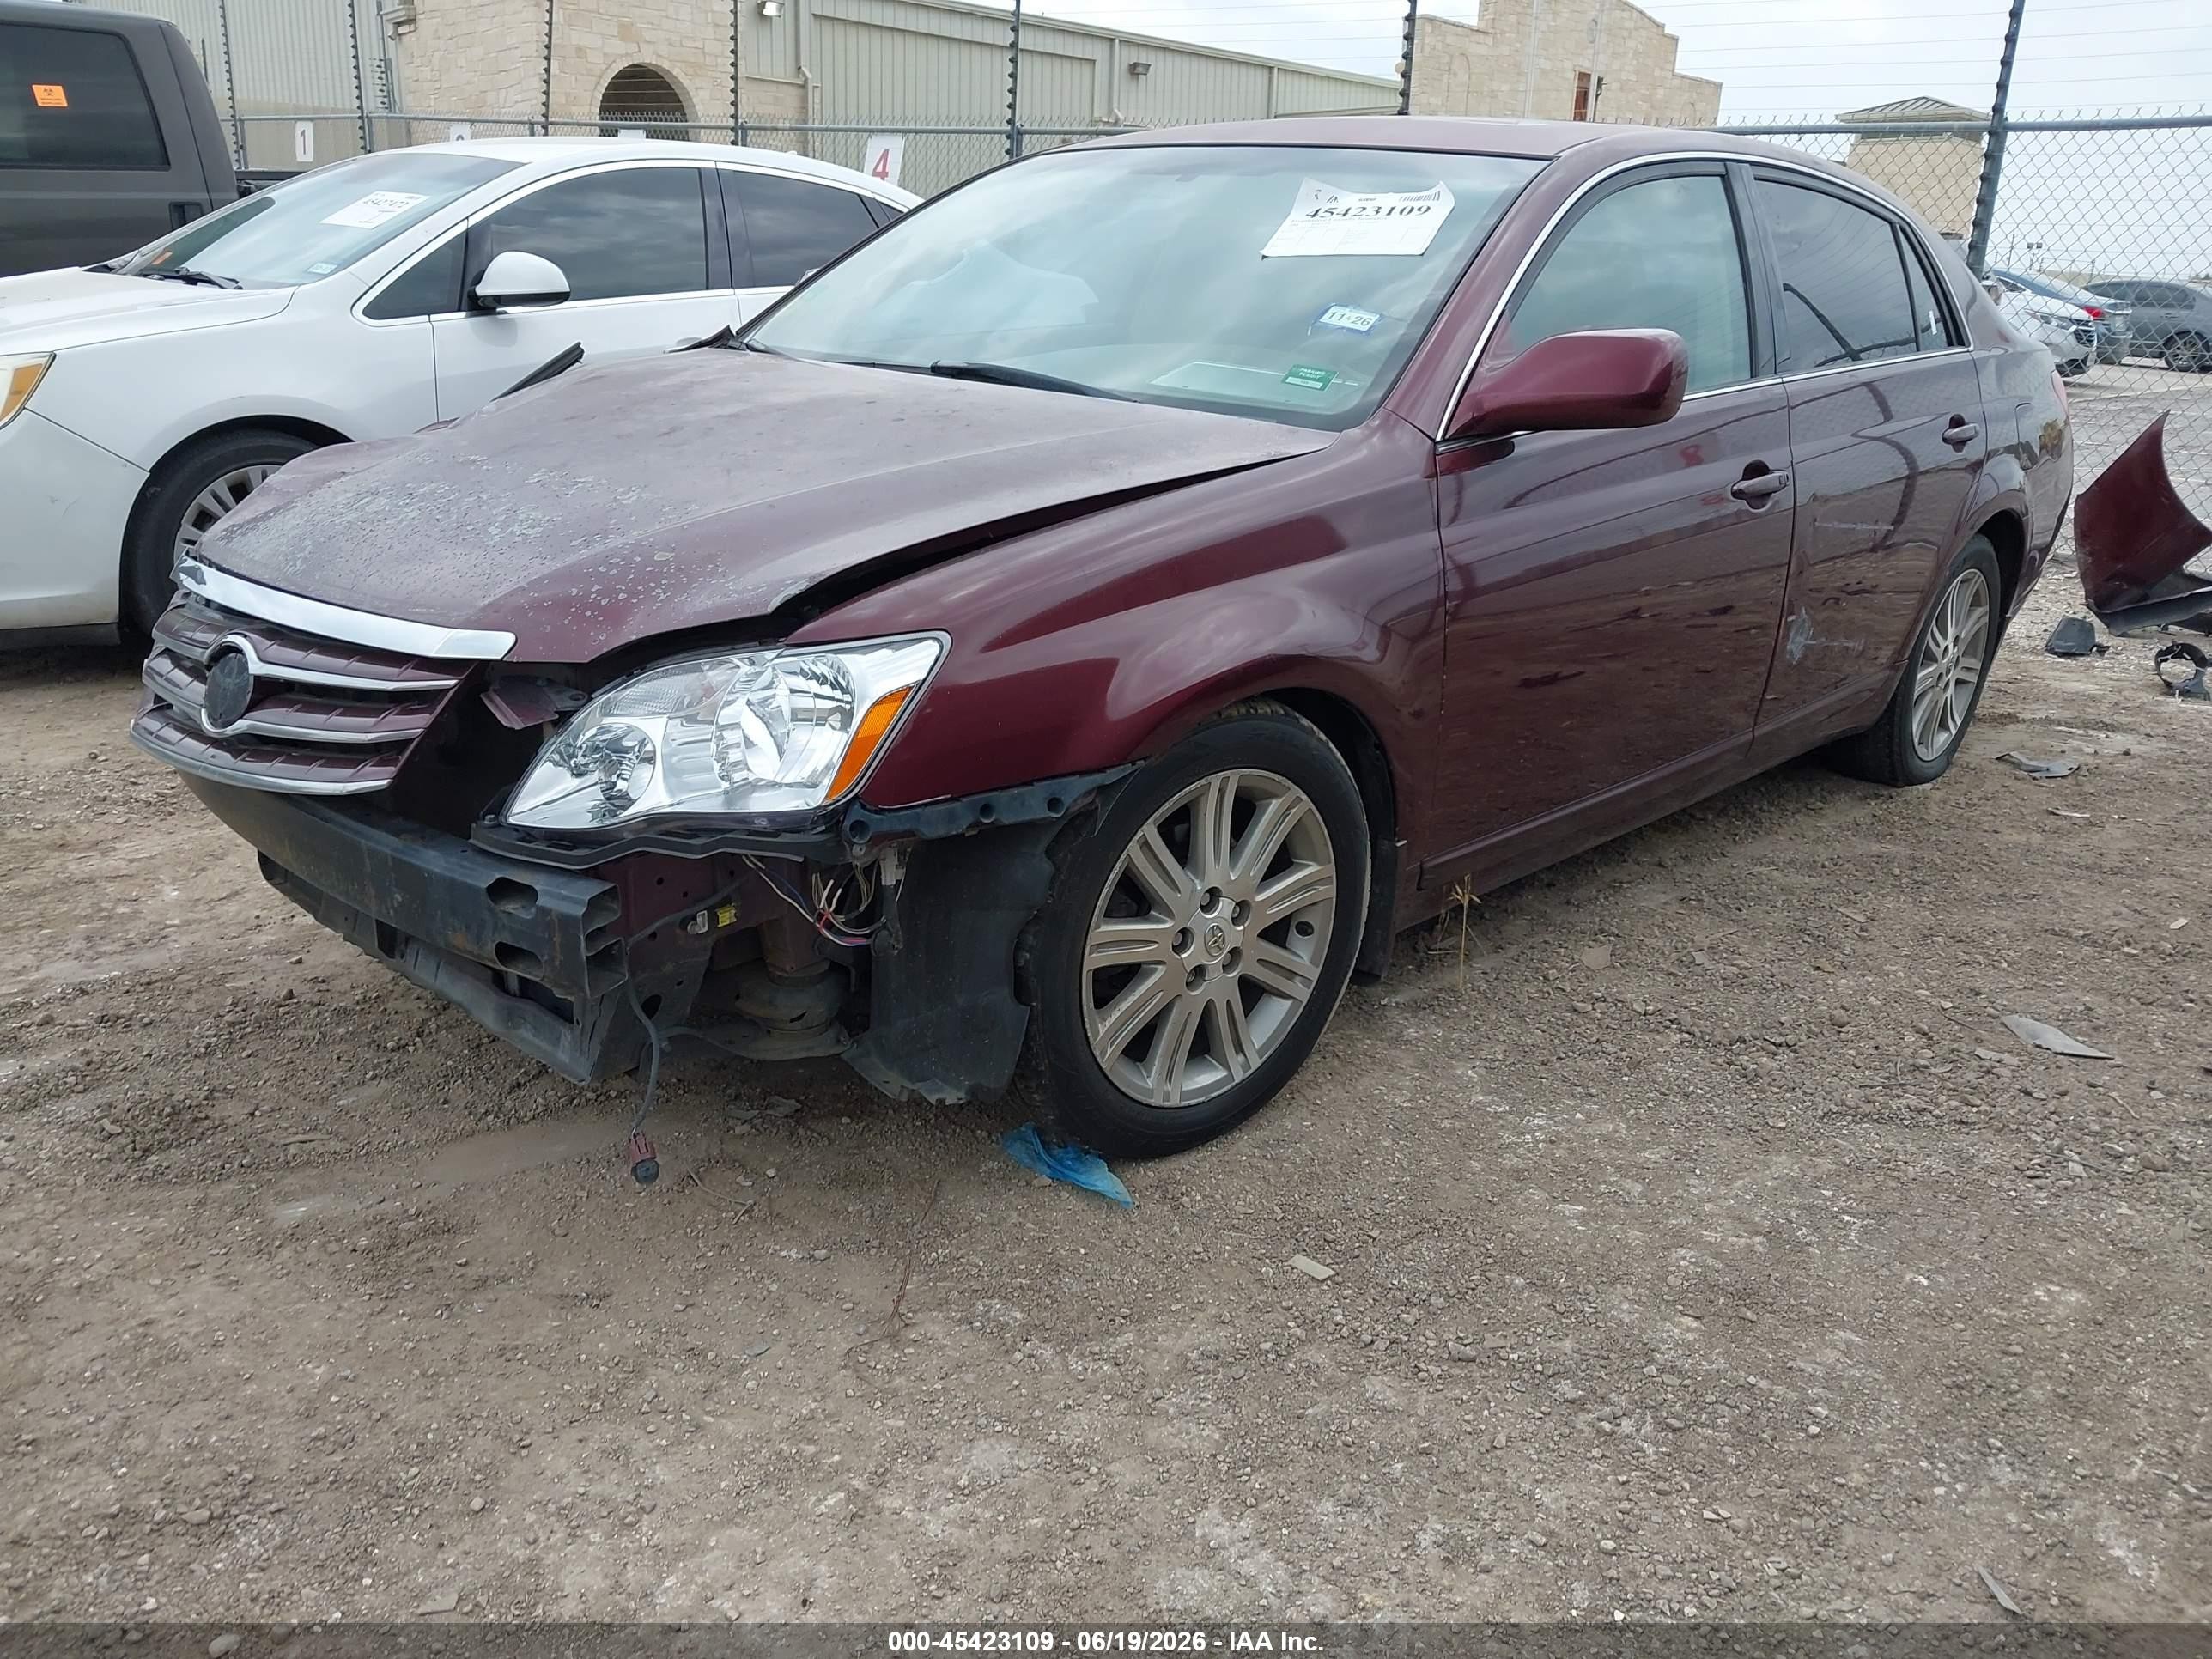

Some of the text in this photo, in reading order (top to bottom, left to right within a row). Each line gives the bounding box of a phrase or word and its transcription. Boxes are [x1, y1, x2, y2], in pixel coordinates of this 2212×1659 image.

[300, 129, 307, 155] 1
[872, 148, 890, 181] 4
[1305, 204, 1431, 219] 45423109
